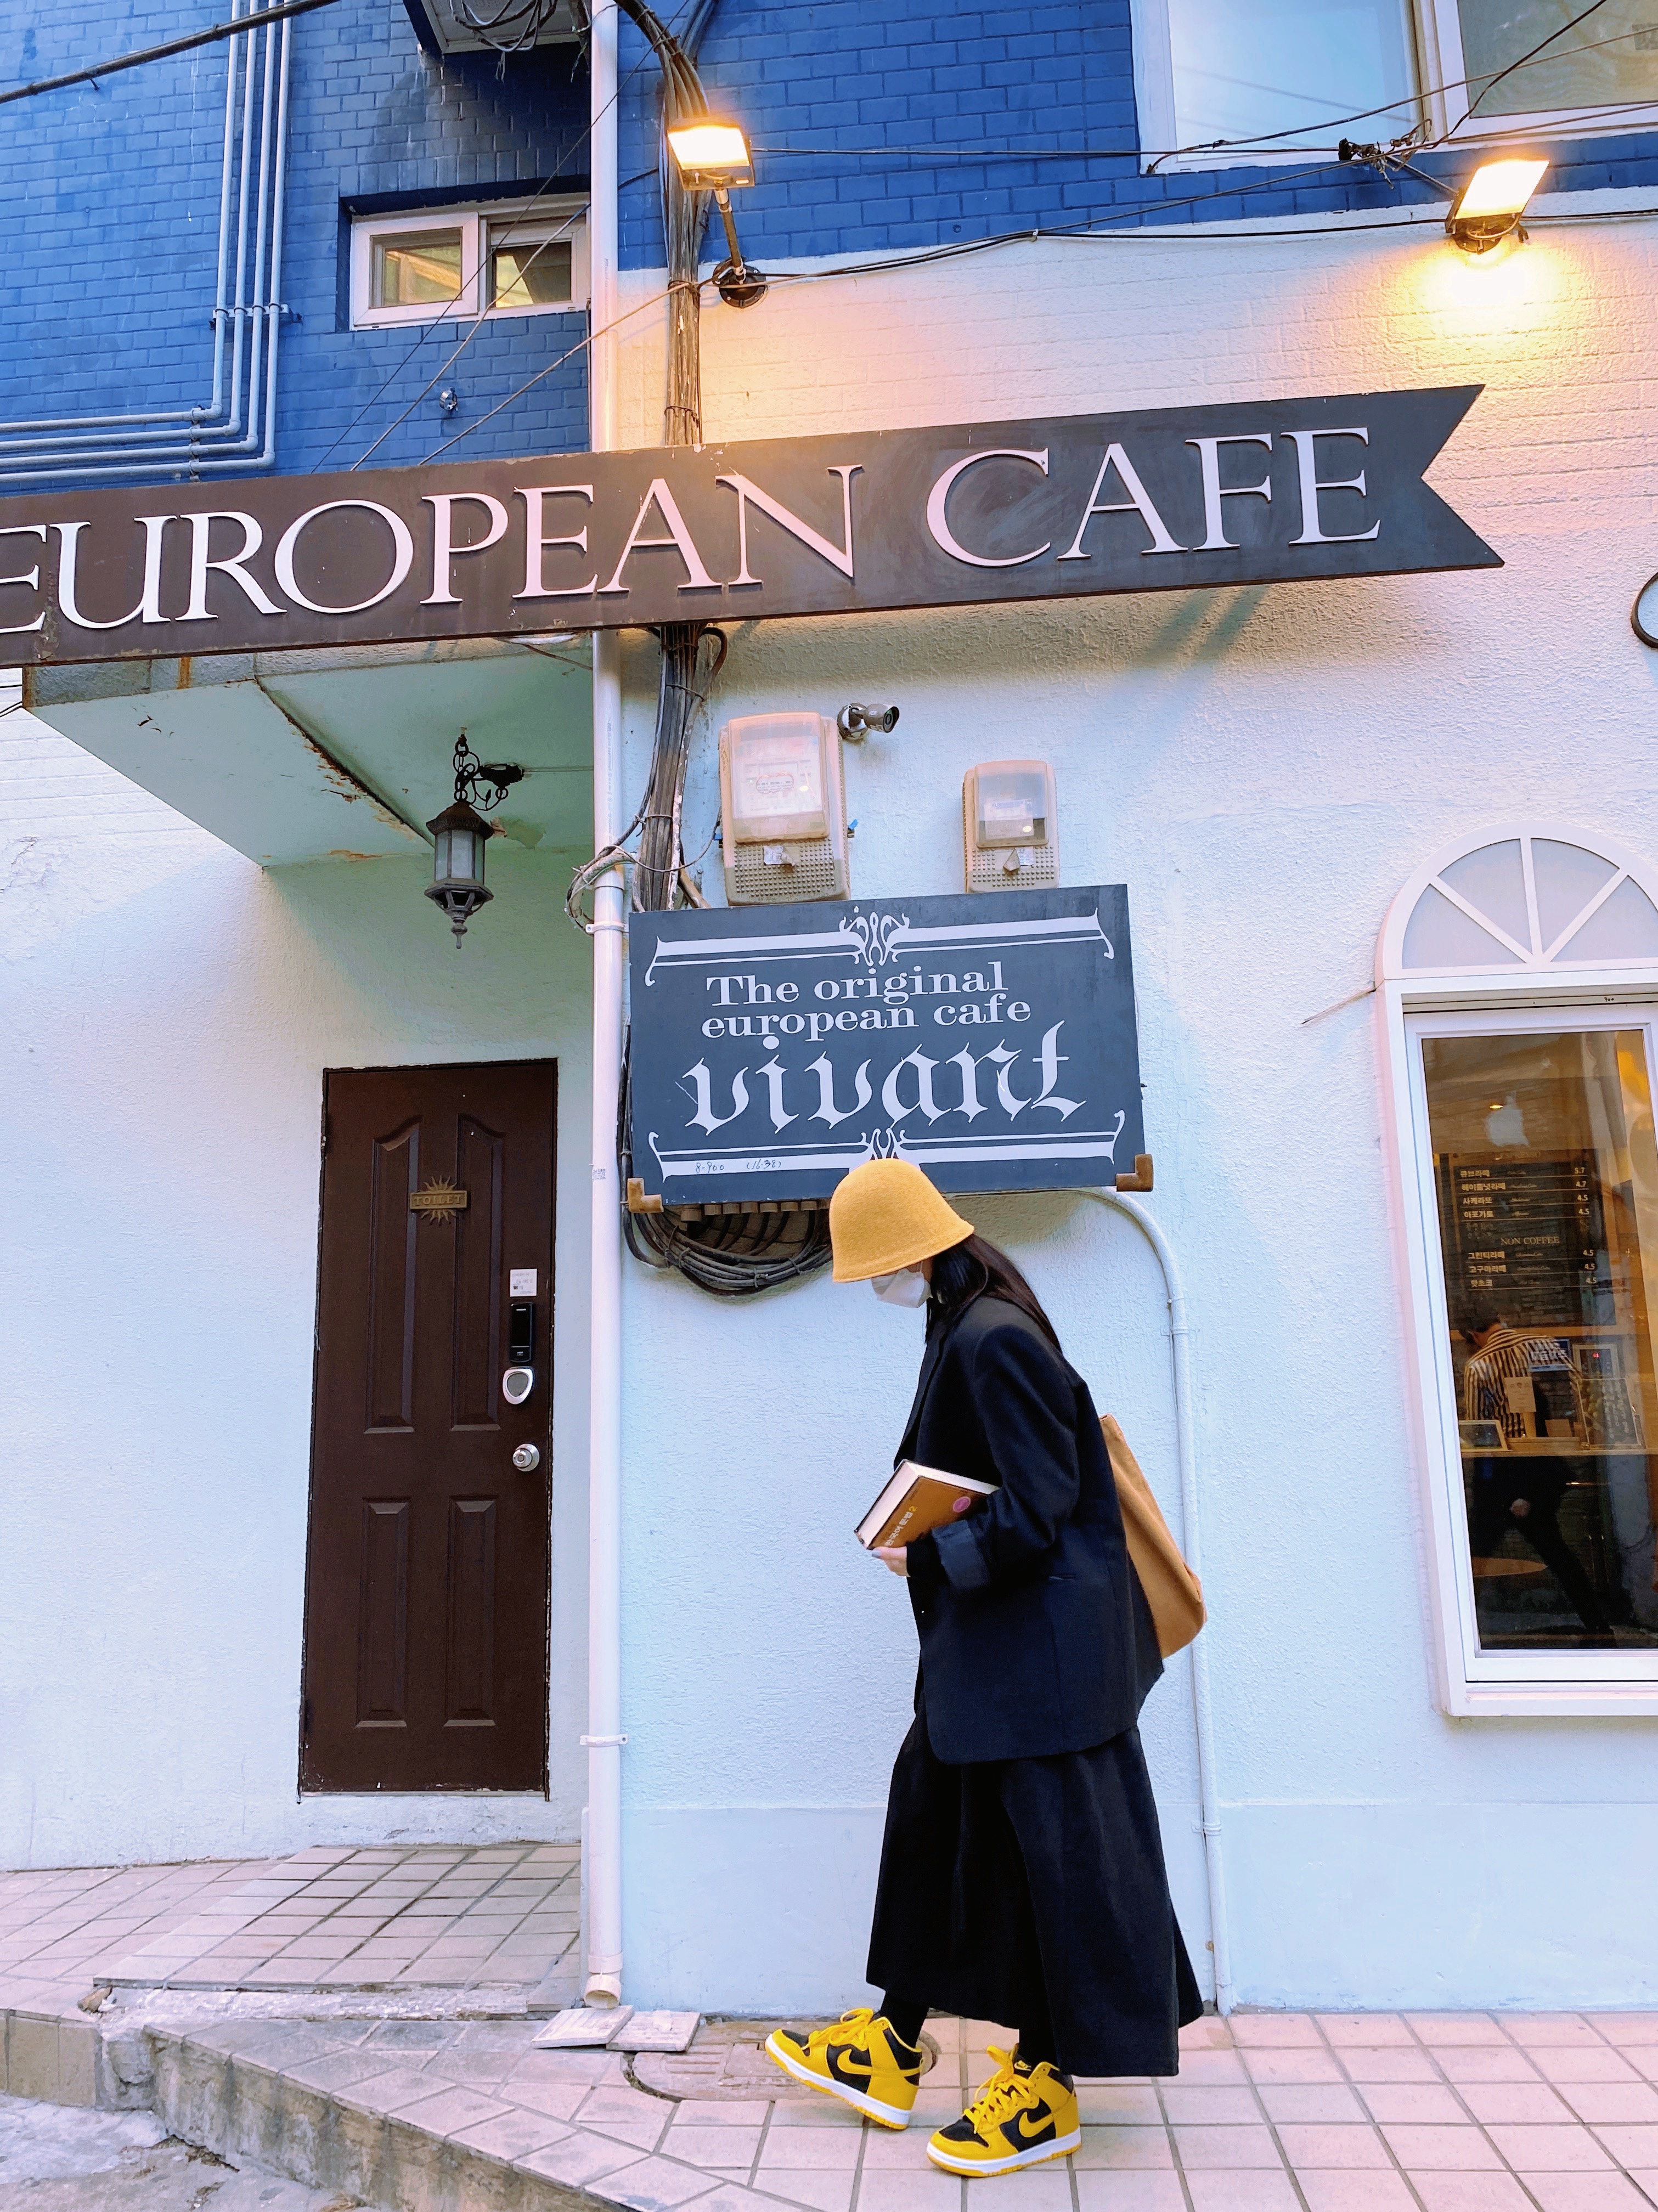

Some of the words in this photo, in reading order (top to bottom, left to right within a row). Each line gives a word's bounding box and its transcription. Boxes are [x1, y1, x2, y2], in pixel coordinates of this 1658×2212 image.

[926, 427, 1381, 568] CAFE
[707, 974, 800, 1007] The
[814, 962, 1008, 1005] original
[701, 1007, 920, 1042] european
[933, 994, 1031, 1026] cafe
[681, 1020, 1087, 1136] vivant
[414, 1195, 461, 1206] TOILET
[1501, 1237, 1521, 1246] NON
[1523, 1236, 1560, 1245] COFFEE
[1468, 1251, 1505, 1260] 그린티라떼
[1469, 1265, 1507, 1274] 고구마라떼
